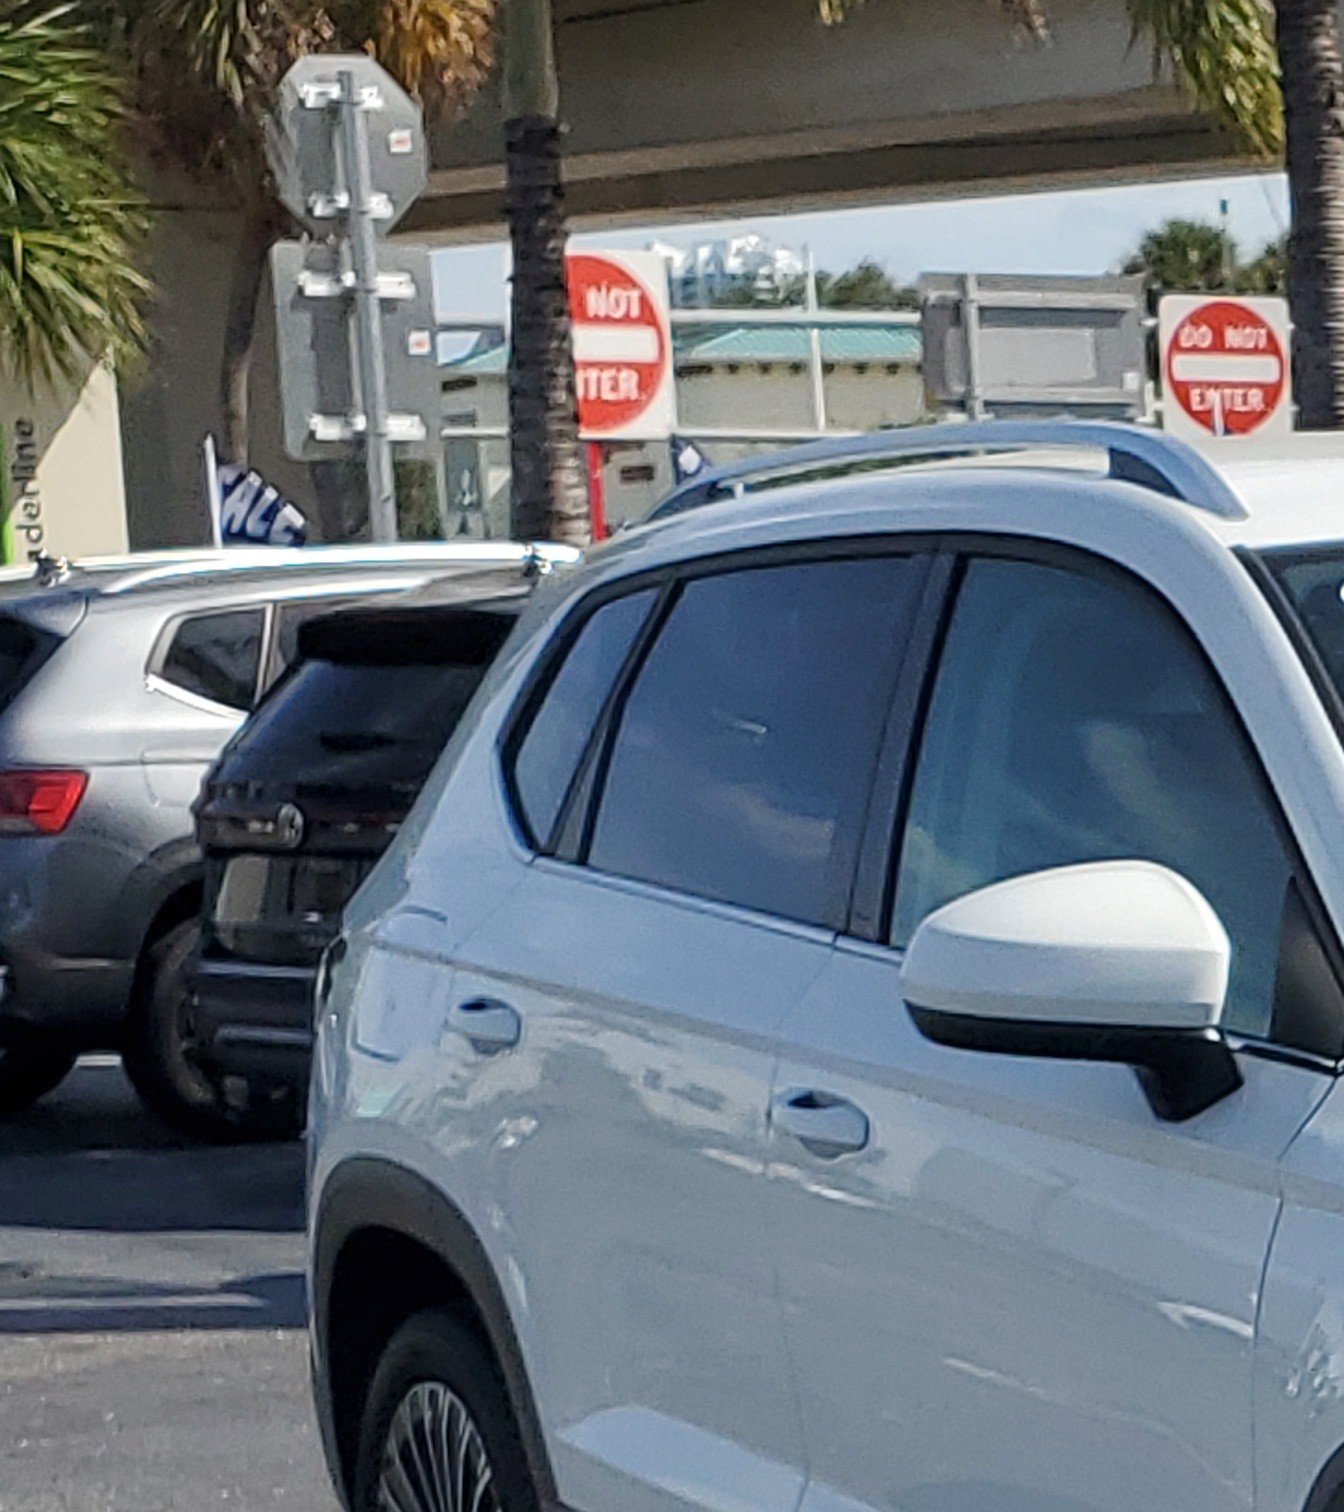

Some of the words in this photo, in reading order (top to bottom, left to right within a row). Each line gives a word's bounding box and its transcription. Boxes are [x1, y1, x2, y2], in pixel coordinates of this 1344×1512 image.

[585, 283, 641, 319] NOT
[1179, 323, 1213, 349] DO
[1224, 324, 1268, 349] NOT
[576, 366, 640, 401] TER
